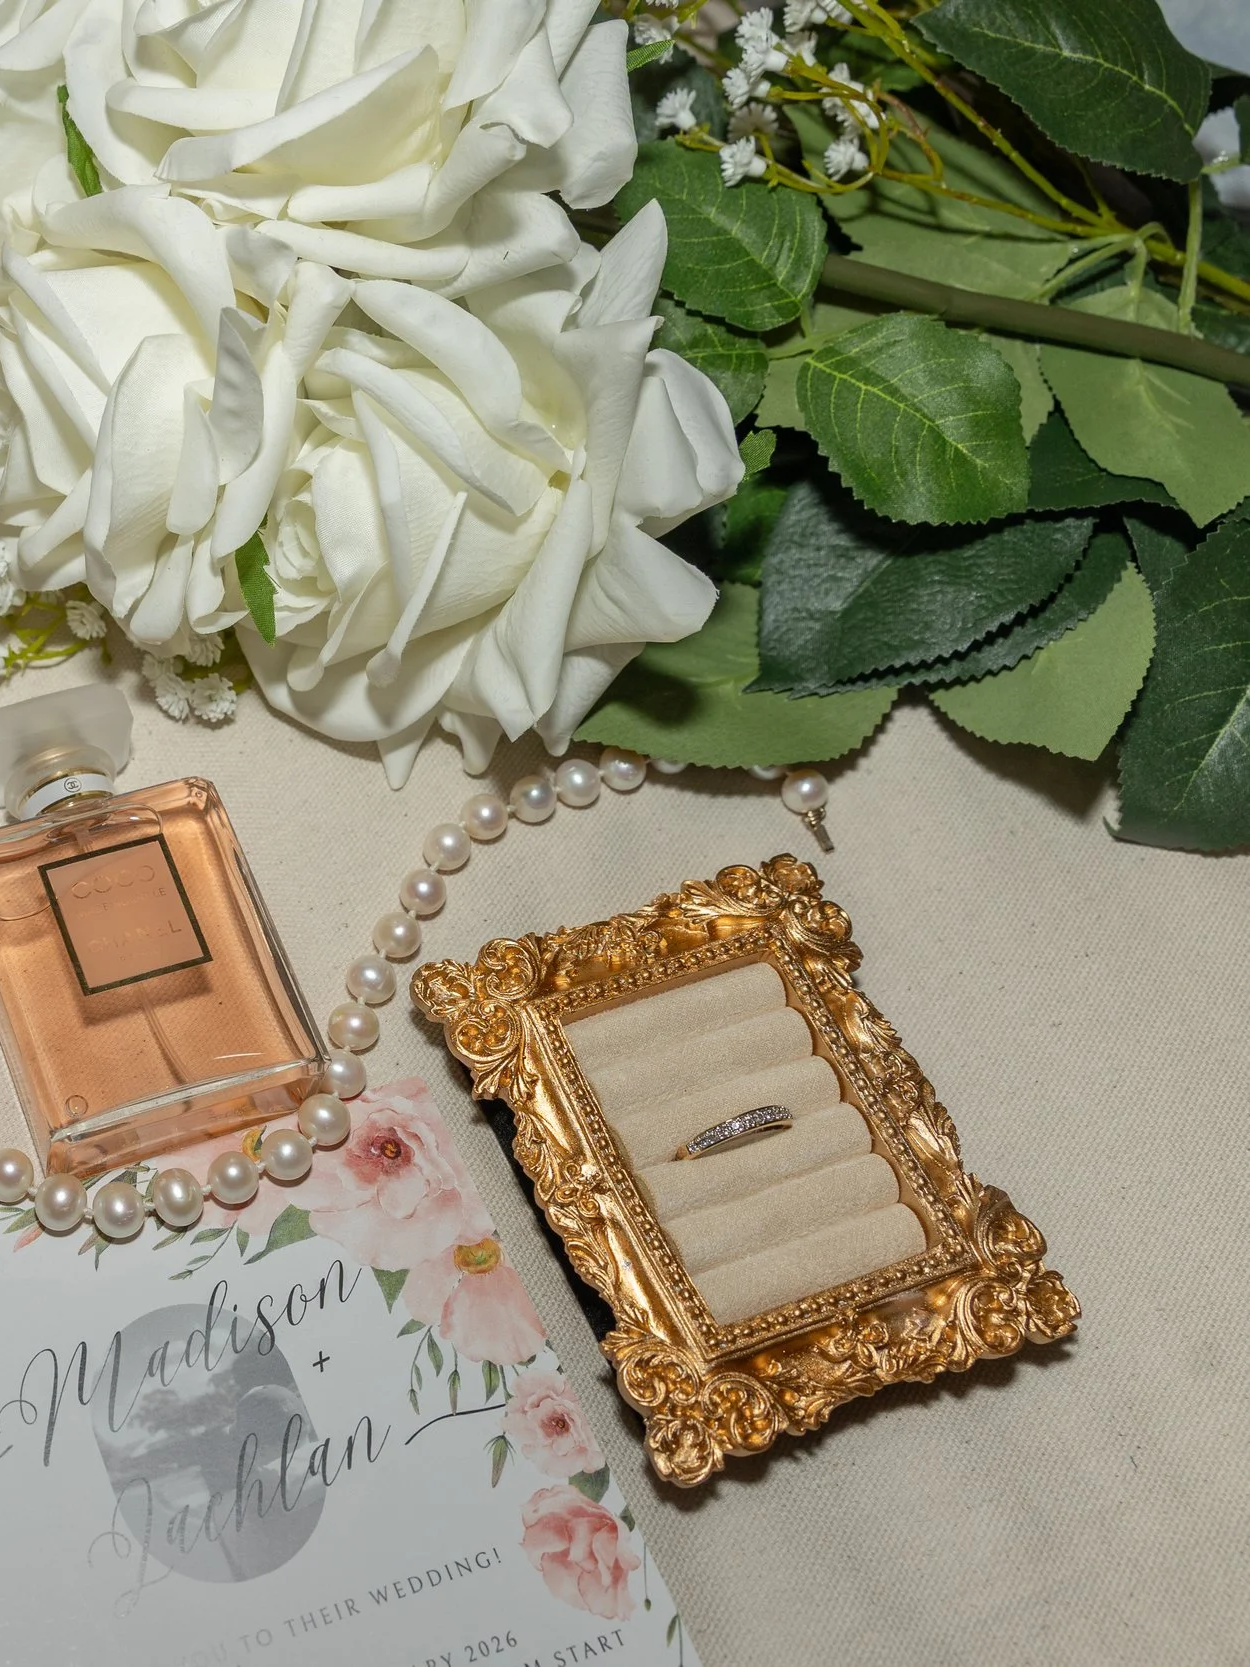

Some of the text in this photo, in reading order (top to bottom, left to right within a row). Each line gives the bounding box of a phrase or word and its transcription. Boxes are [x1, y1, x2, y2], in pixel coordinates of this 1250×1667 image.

[87, 1413, 391, 1618] Lachlan
[238, 1628, 274, 1653] TO
[283, 1597, 362, 1638] THEIR
[368, 1547, 503, 1606] WEDDING!
[463, 1630, 518, 1663] 2026
[553, 1628, 626, 1667] START
